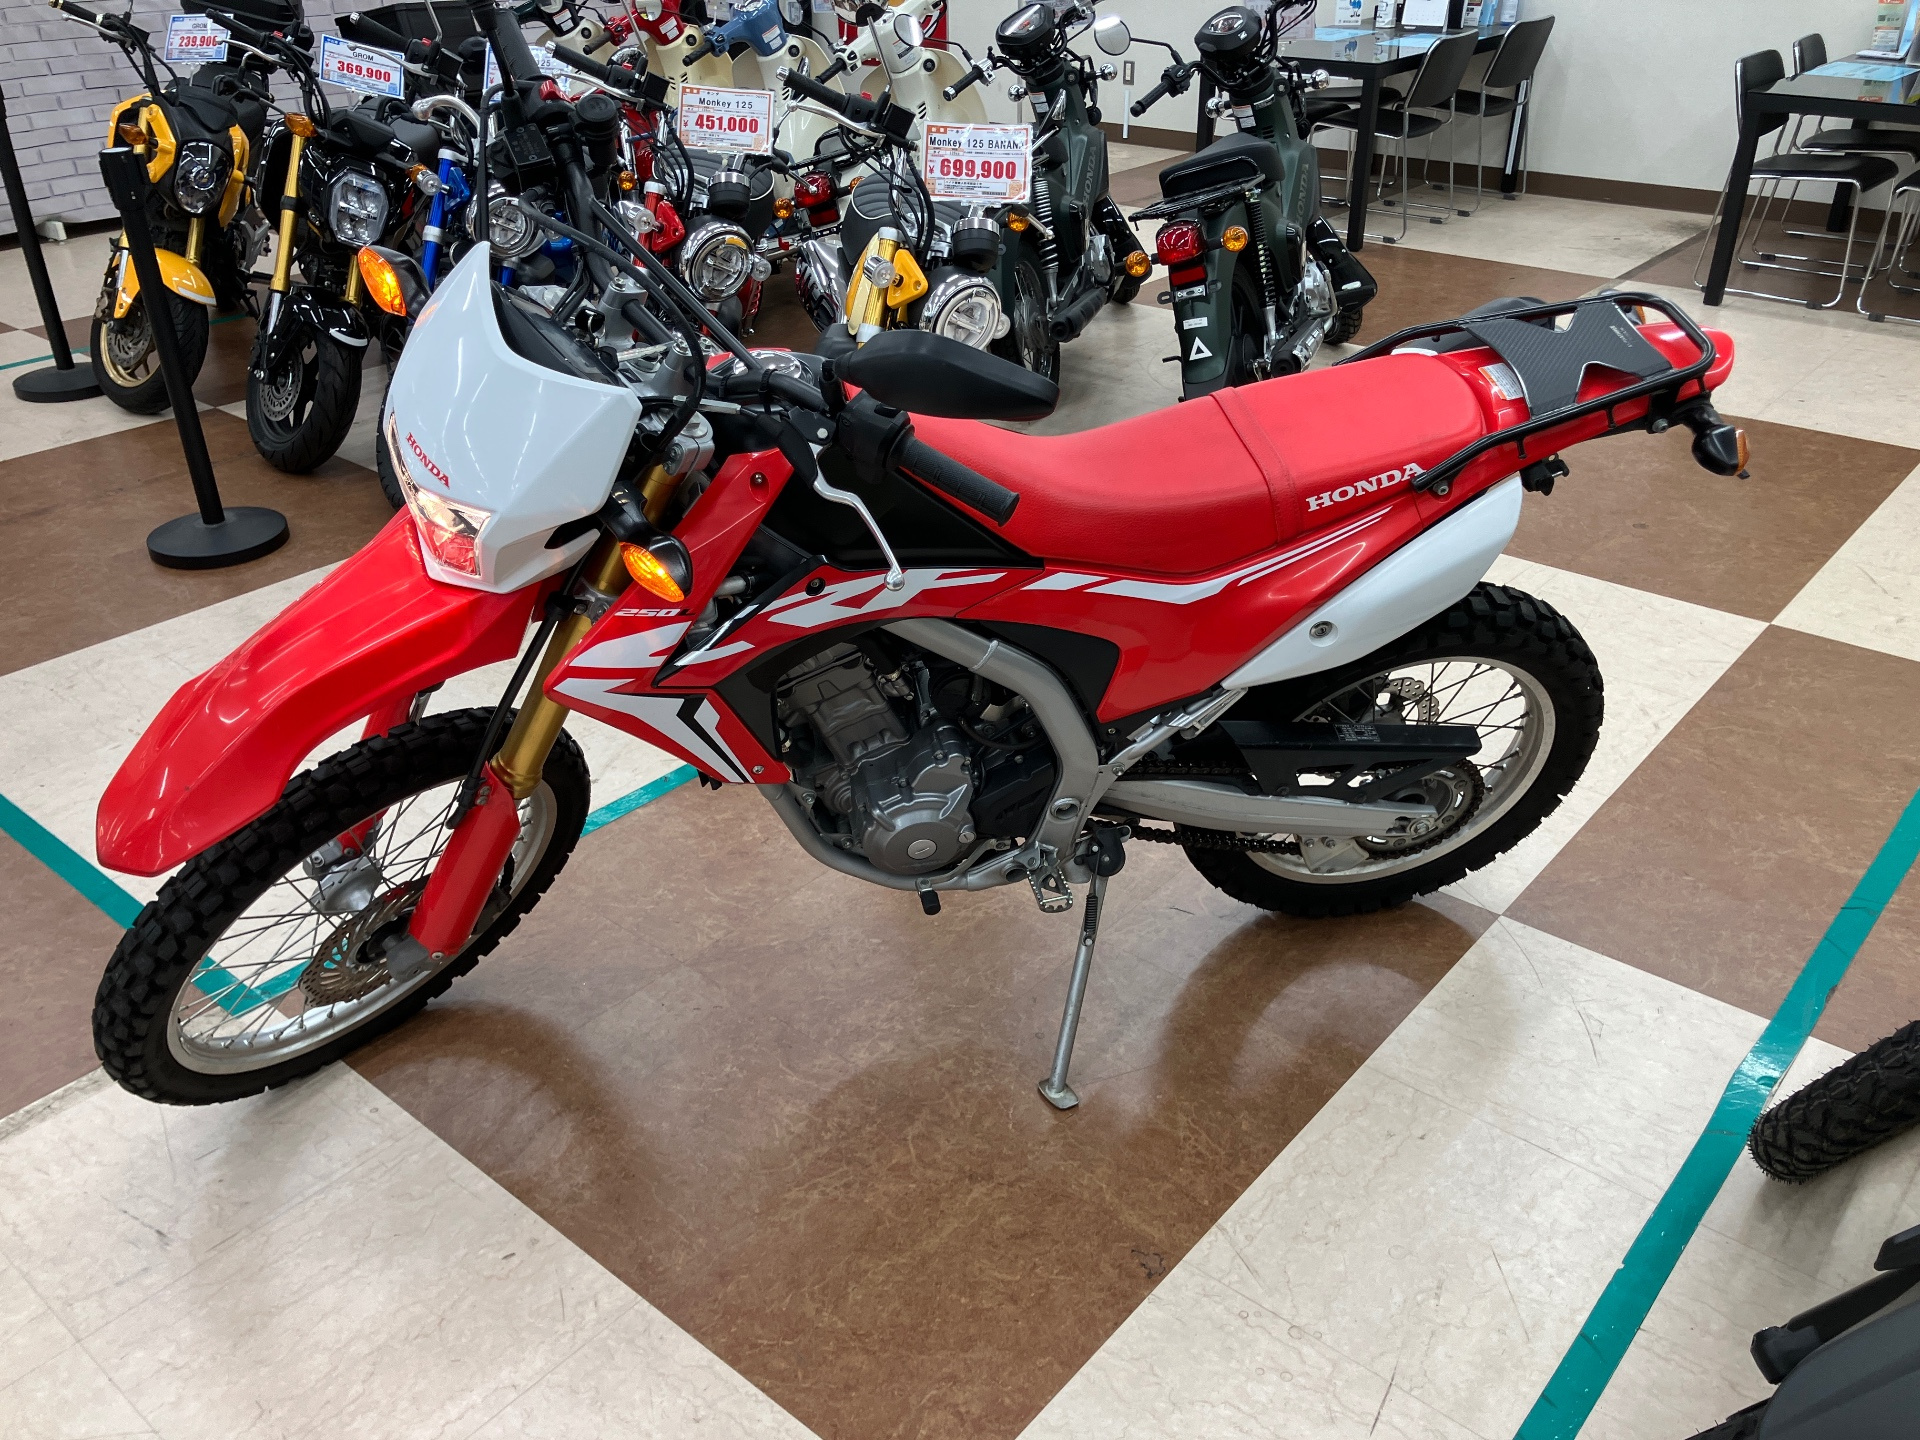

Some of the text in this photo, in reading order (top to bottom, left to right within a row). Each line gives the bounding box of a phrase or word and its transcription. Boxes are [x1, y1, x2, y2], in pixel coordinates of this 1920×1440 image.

[352, 51, 374, 62] GROM
[337, 60, 391, 83] 369,900
[698, 97, 732, 109] Monkey
[735, 100, 753, 109] 125
[683, 113, 759, 133] ¥ 451,000
[929, 136, 962, 148] Monkey
[967, 139, 984, 148] 125
[928, 158, 1017, 180] ¥ 699,900
[405, 431, 450, 490] HONDA
[1305, 462, 1427, 512] HONDA
[614, 607, 697, 617] 250L
